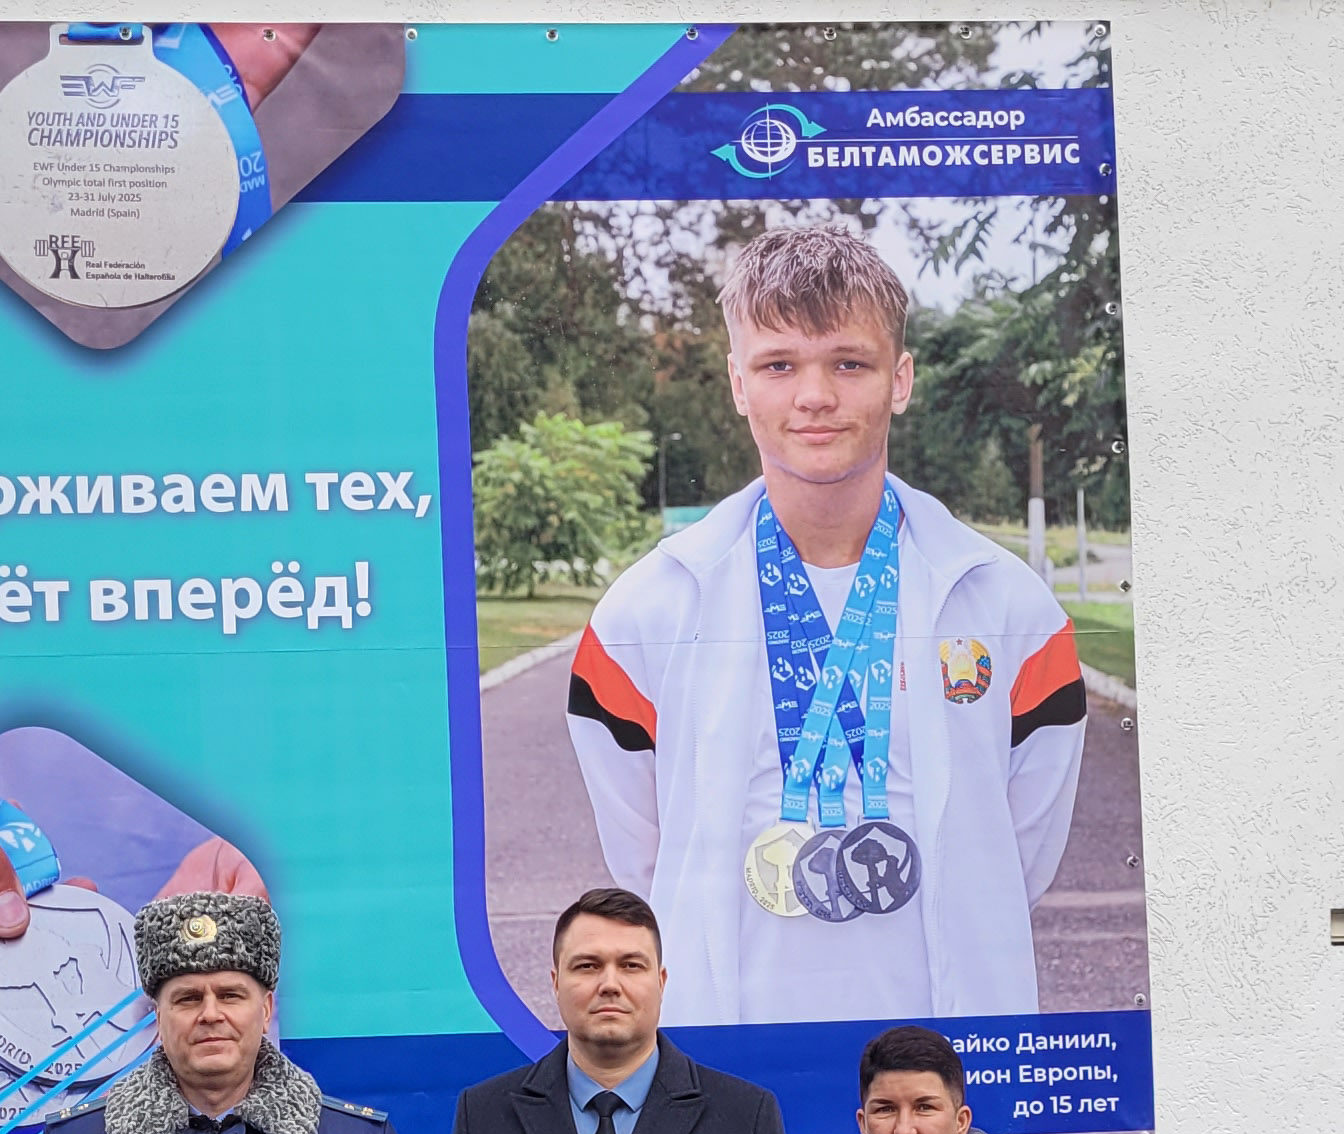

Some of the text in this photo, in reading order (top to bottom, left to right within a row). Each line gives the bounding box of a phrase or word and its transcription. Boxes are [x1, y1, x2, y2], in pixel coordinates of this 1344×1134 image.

[27, 111, 180, 129] YOUTH AND UNDER 15
[866, 106, 1025, 130] Амбассадор
[27, 128, 180, 149] CHAMPIONSHIPS
[239, 151, 264, 177] 20
[807, 143, 1081, 168] БЕЛТАМОЖСЕРВИС
[33, 162, 176, 174] EWF Under 15 Championships
[42, 177, 168, 189] Olympic total first position
[67, 192, 142, 204] 23-31 July 2025
[70, 207, 141, 219] Madrid (Spain)
[86, 261, 102, 269] Real
[123, 272, 133, 280] de
[304, 469, 432, 519] тех,
[88, 560, 373, 635] вперёд!
[767, 629, 790, 641] 2025
[790, 638, 808, 650] 202
[944, 1031, 1117, 1054] айко Даниил,
[965, 1064, 1118, 1086] ион Европы,
[1013, 1095, 1119, 1118] до 15 лет
